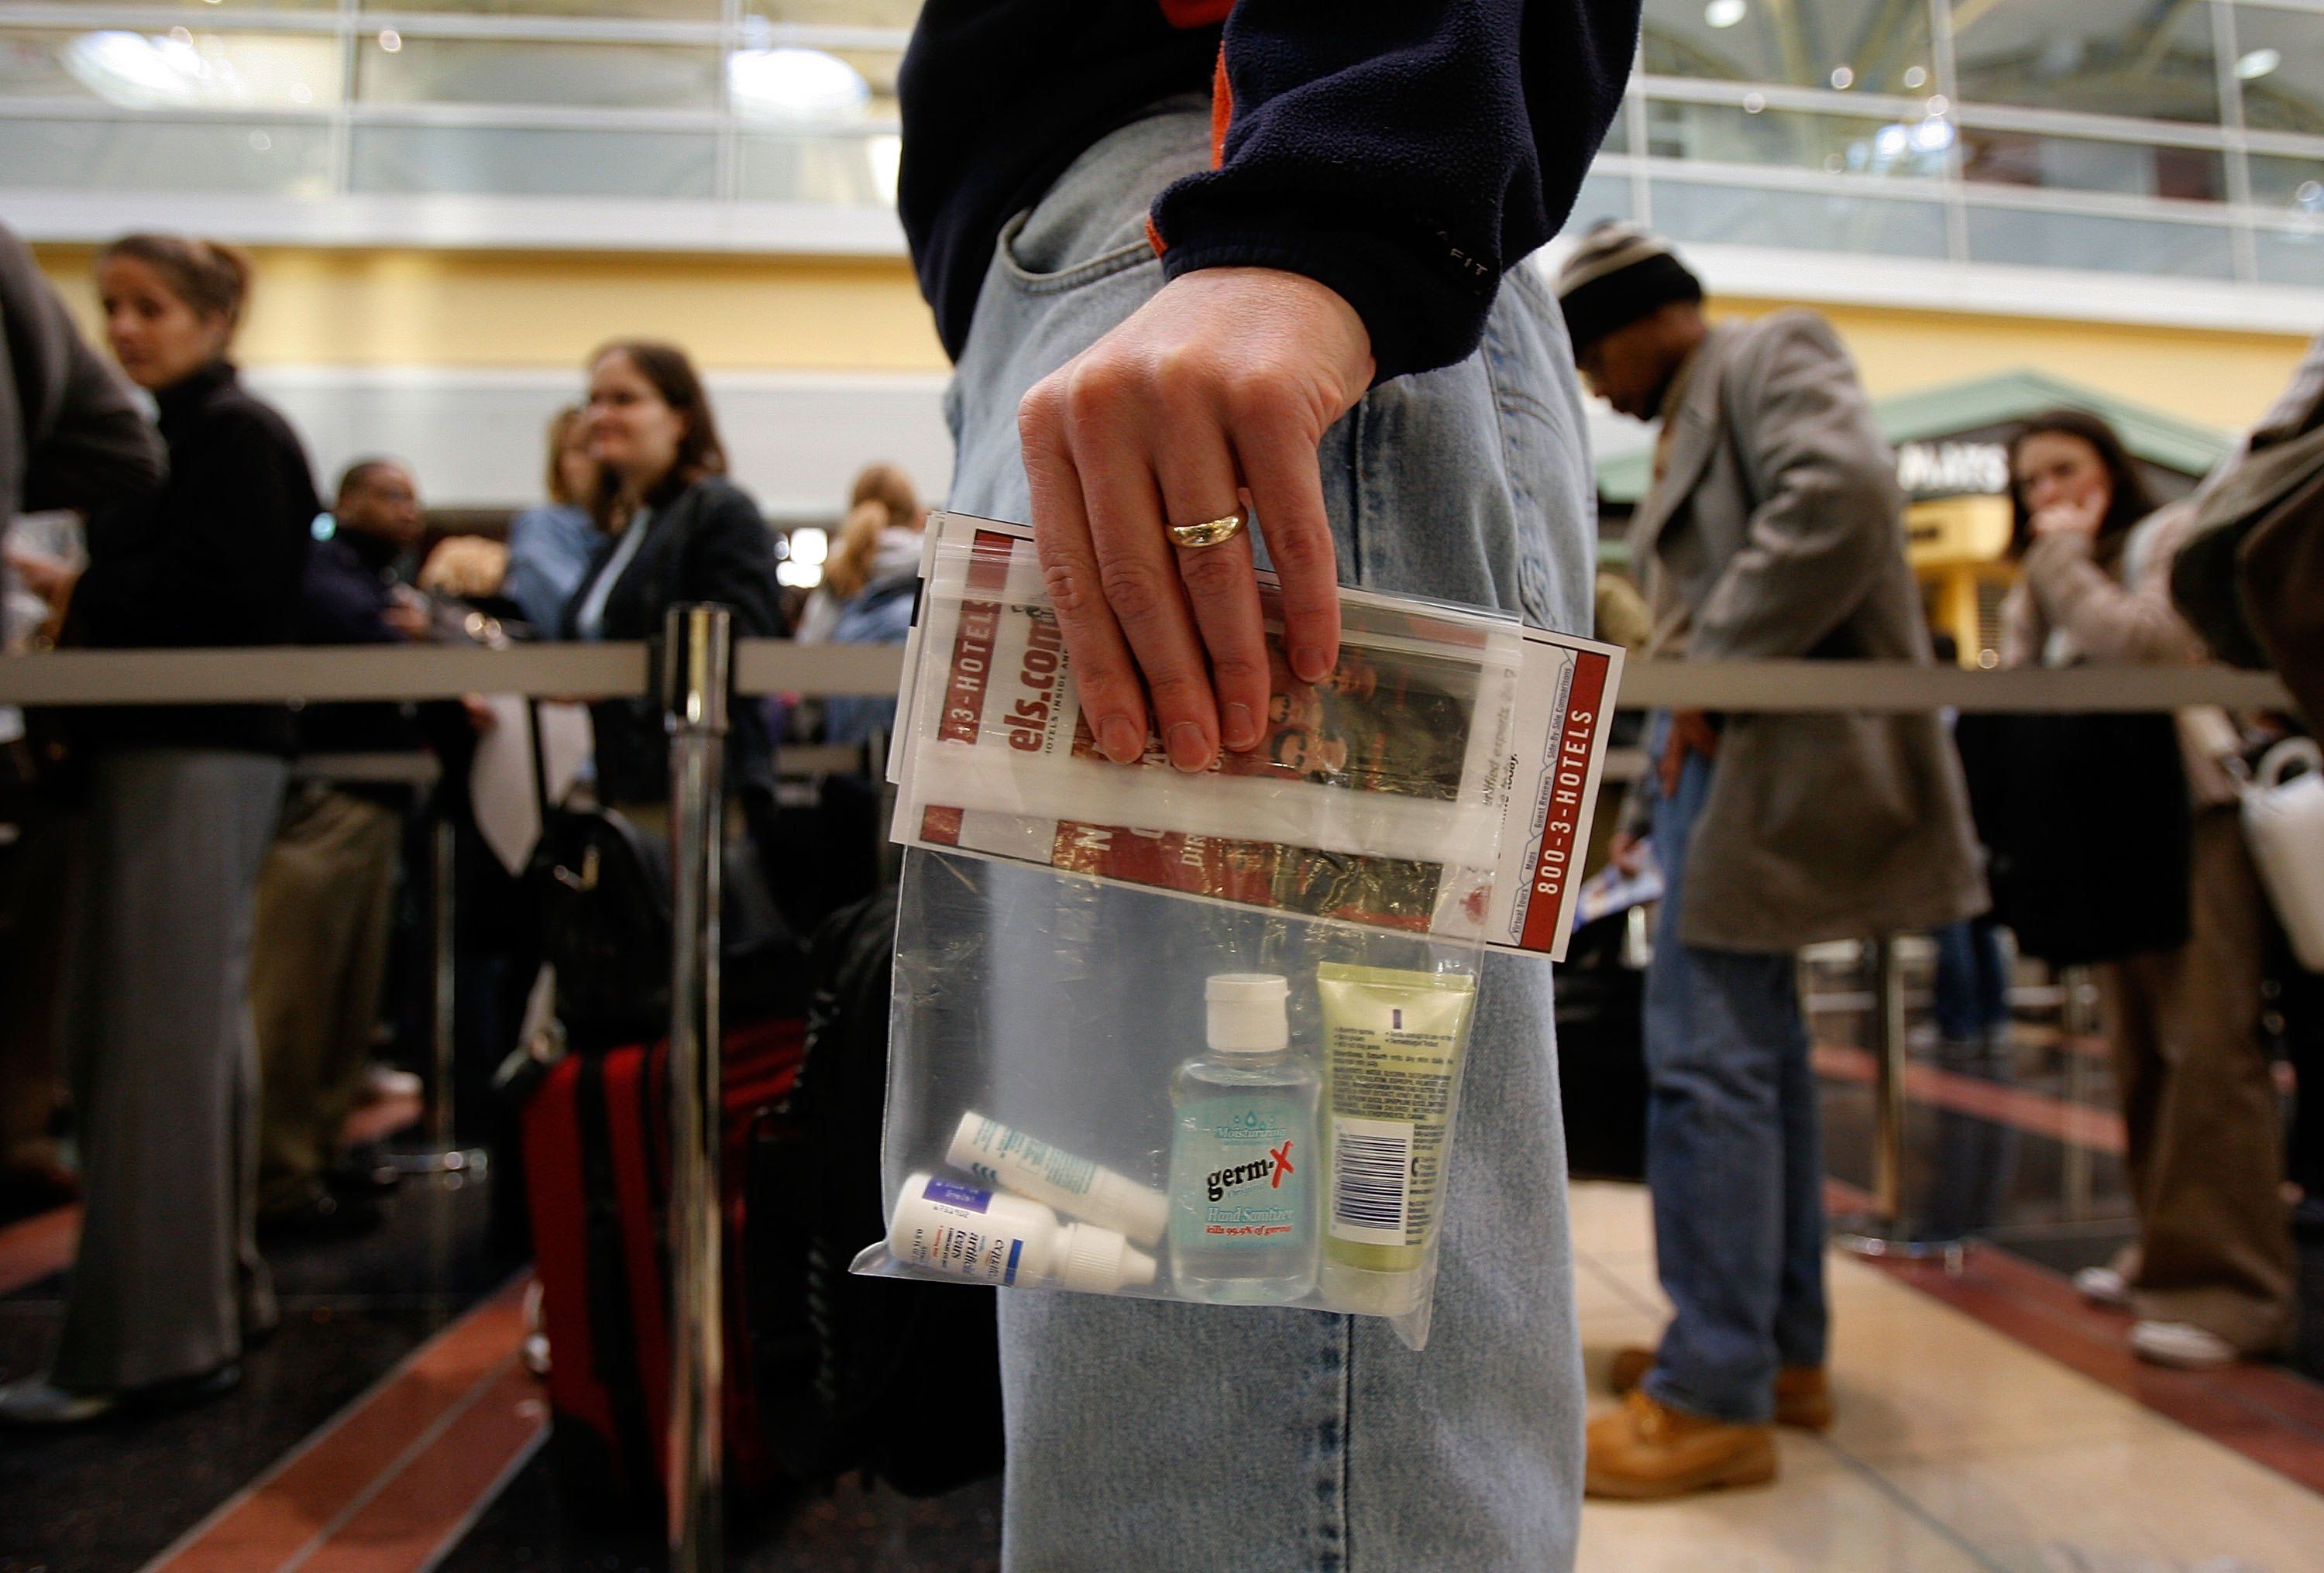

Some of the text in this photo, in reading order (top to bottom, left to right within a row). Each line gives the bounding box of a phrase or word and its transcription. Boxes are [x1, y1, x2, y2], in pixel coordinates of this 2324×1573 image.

[1450, 248, 1488, 276] FIT
[1053, 675, 1067, 711] INSIDE
[1556, 668, 1573, 713] Comparisons
[1535, 776, 1552, 829] Guest Reviews
[1537, 709, 1593, 895] 800-3-HOTELS
[1525, 851, 1537, 871] Maps
[1512, 888, 1528, 933] Virtual Tours
[1205, 1140, 1294, 1202] germ-X
[1206, 1207, 1242, 1223] Hand
[1206, 1224, 1225, 1235] kills
[1255, 1224, 1265, 1236] of
